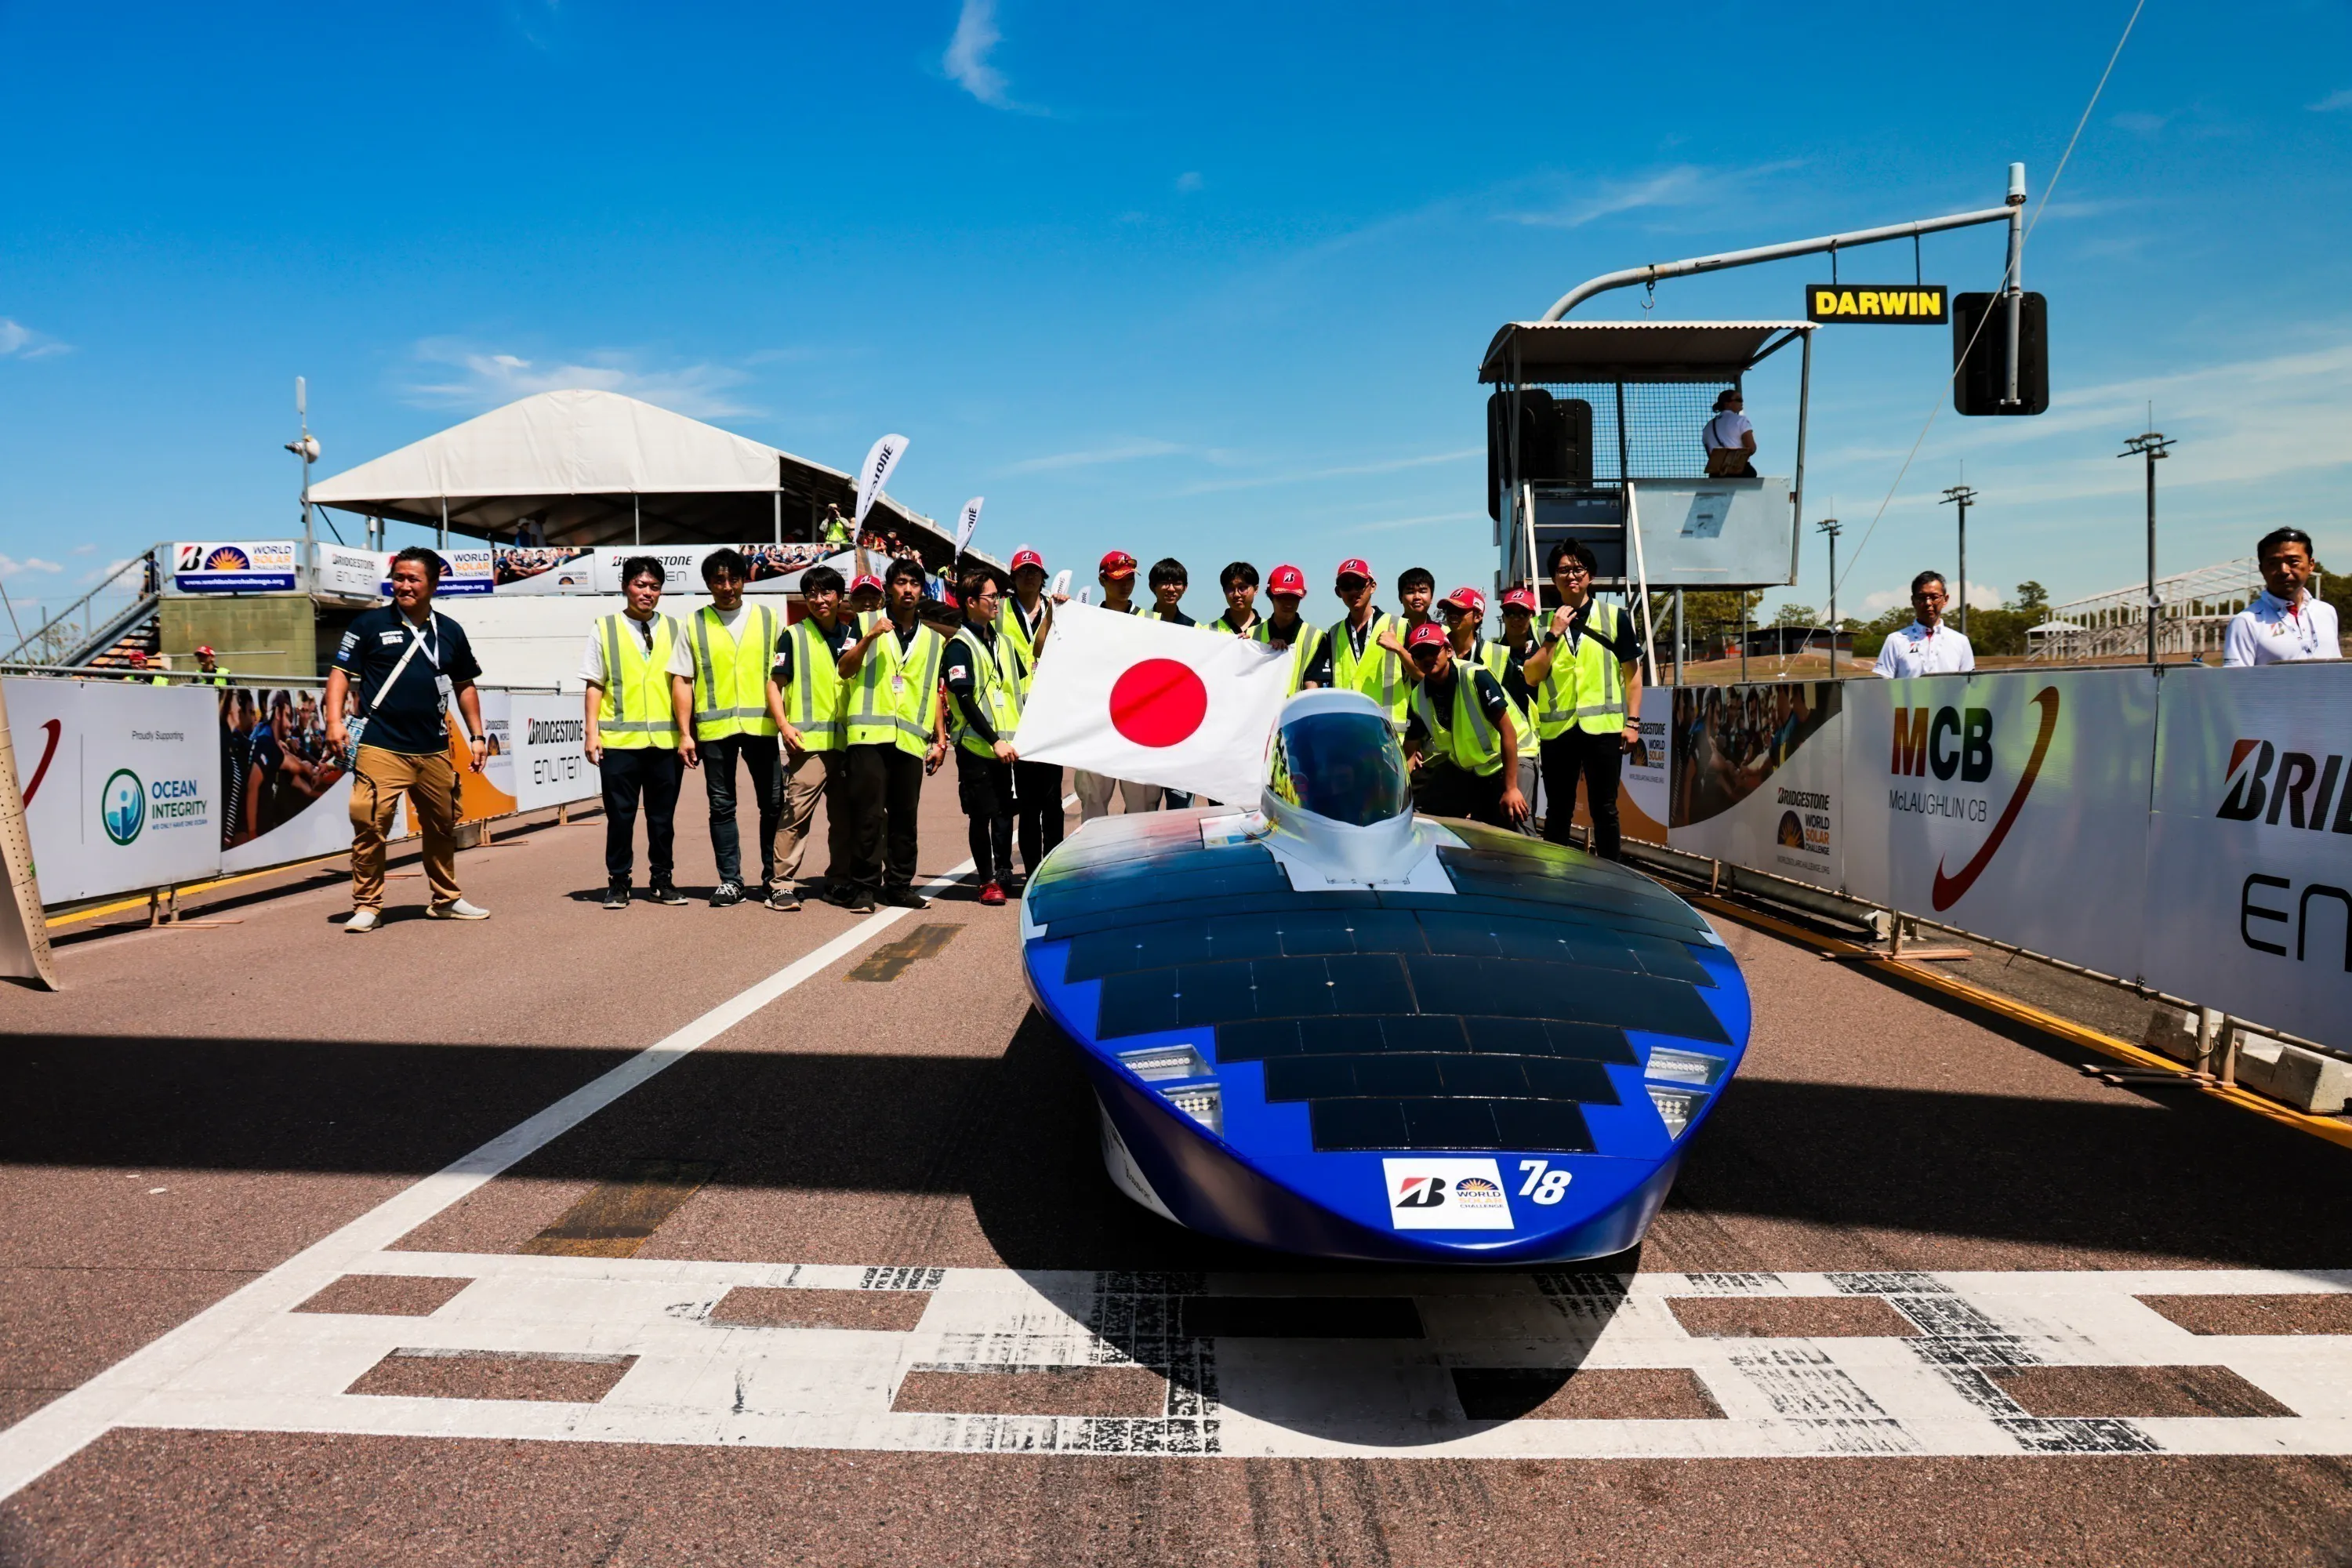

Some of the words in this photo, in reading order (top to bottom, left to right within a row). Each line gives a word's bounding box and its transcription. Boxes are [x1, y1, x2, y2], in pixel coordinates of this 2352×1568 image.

[1815, 291, 1941, 316] DARWIN
[252, 546, 292, 554] WORLD
[454, 553, 490, 562] WORLD
[253, 555, 291, 564] SOLAR
[332, 553, 375, 571] BRIDGESTONE
[455, 562, 490, 571] SOLAR
[131, 730, 154, 742] Proudly
[155, 730, 184, 742] Supporting
[528, 717, 583, 746] BRIDGESTONE
[1648, 739, 1665, 750] WORLD
[1891, 706, 1994, 783] MCB
[1648, 750, 1665, 761] SOLAR
[151, 779, 198, 799] OCEAN
[2216, 739, 2352, 836] BRI
[1777, 786, 1831, 811] BRIDGESTONE
[1889, 789, 1965, 819] McLAUGHLIN
[1968, 799, 1987, 822] CB
[151, 800, 208, 820] INTEGRITY
[1805, 813, 1830, 829] WORLD
[1805, 828, 1830, 845] SOLAR
[1805, 843, 1831, 856] CHALLENGE
[1518, 1160, 1573, 1205] 78
